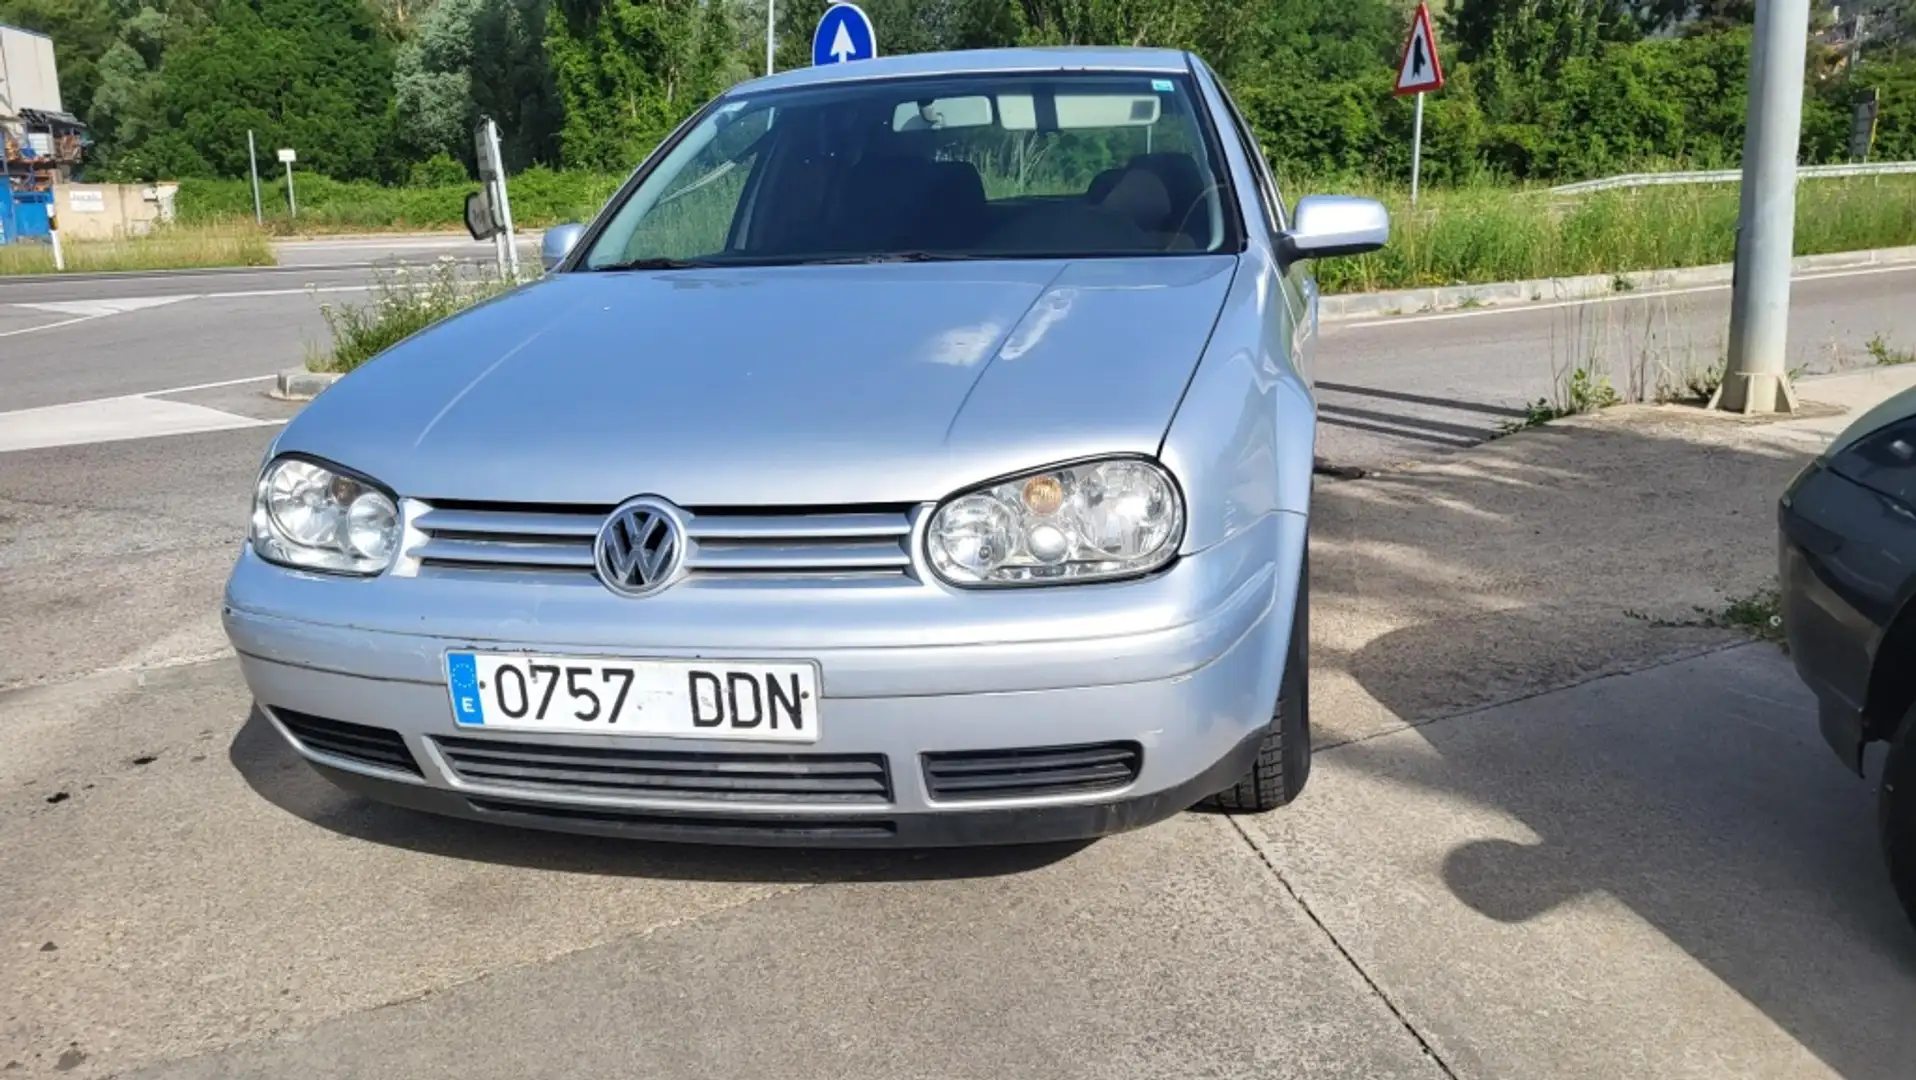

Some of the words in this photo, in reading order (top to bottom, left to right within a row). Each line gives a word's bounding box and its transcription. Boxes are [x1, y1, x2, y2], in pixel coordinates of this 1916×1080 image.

[601, 507, 677, 588] VW
[462, 696, 476, 713] E
[494, 664, 634, 723] 0757
[688, 670, 803, 729] DDN
